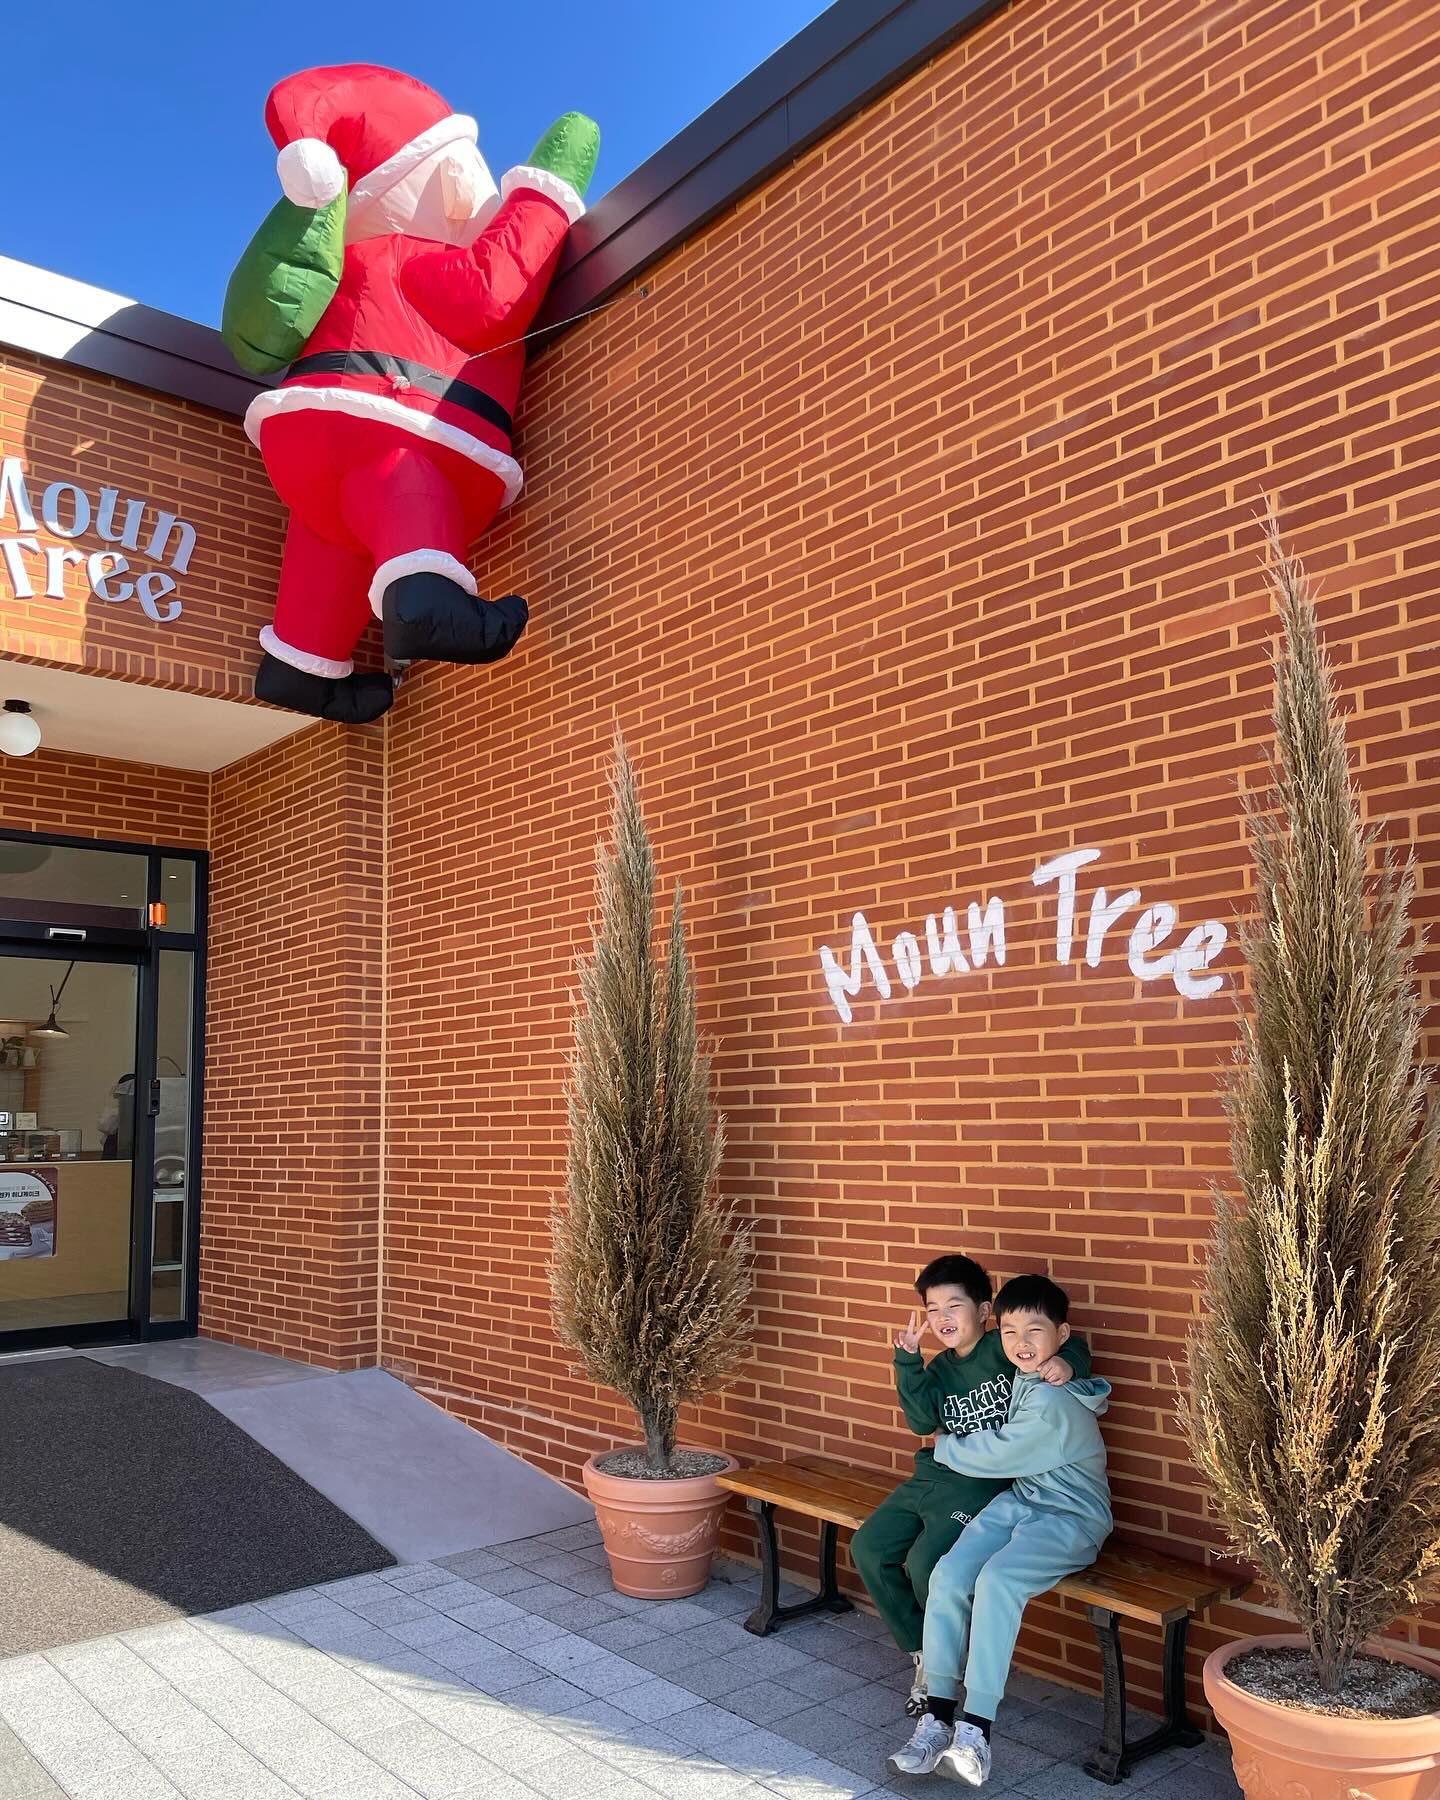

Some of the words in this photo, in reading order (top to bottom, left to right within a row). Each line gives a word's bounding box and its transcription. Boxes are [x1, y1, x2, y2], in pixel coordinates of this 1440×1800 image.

[0, 538, 183, 623] Tree
[818, 896, 1006, 1023] Moun
[1031, 848, 1228, 999] Tree
